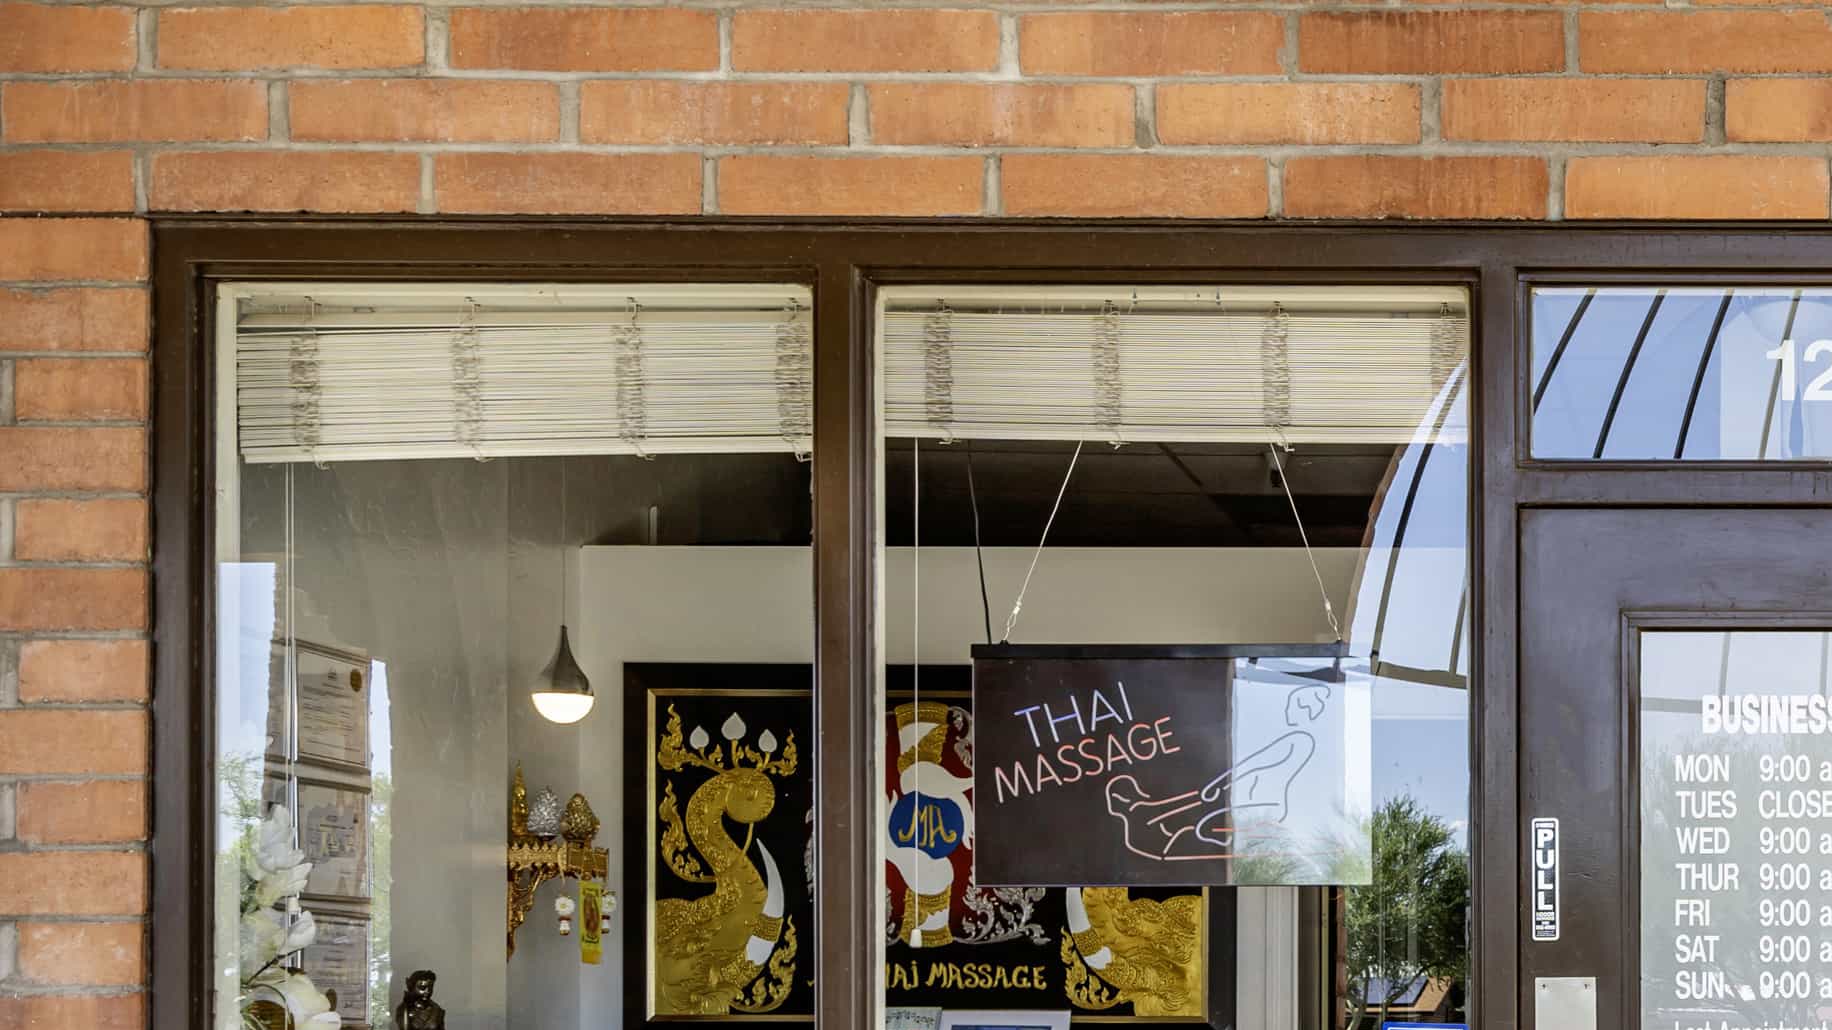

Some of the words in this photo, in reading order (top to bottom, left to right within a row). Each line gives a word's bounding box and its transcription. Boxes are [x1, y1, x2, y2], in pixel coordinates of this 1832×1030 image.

[1013, 680, 1134, 748] THAI
[993, 715, 1181, 804] MASSAGE
[1675, 754, 1730, 782] MON
[1759, 754, 1811, 782] 9:00
[1676, 790, 1737, 818] TUES
[1675, 826, 1730, 855] WED
[1759, 826, 1811, 855] 9:00
[1536, 829, 1554, 910] PULL
[1675, 862, 1739, 891] THUR
[1759, 862, 1811, 891] 9:00
[1675, 899, 1711, 926] FRI
[1759, 899, 1811, 926] 9:00
[1675, 935, 1719, 963] SAT
[1759, 935, 1811, 963] 9:00
[925, 960, 1048, 991] MASSAGE
[1675, 971, 1726, 999] SUN
[1759, 971, 1811, 999] 9:00
